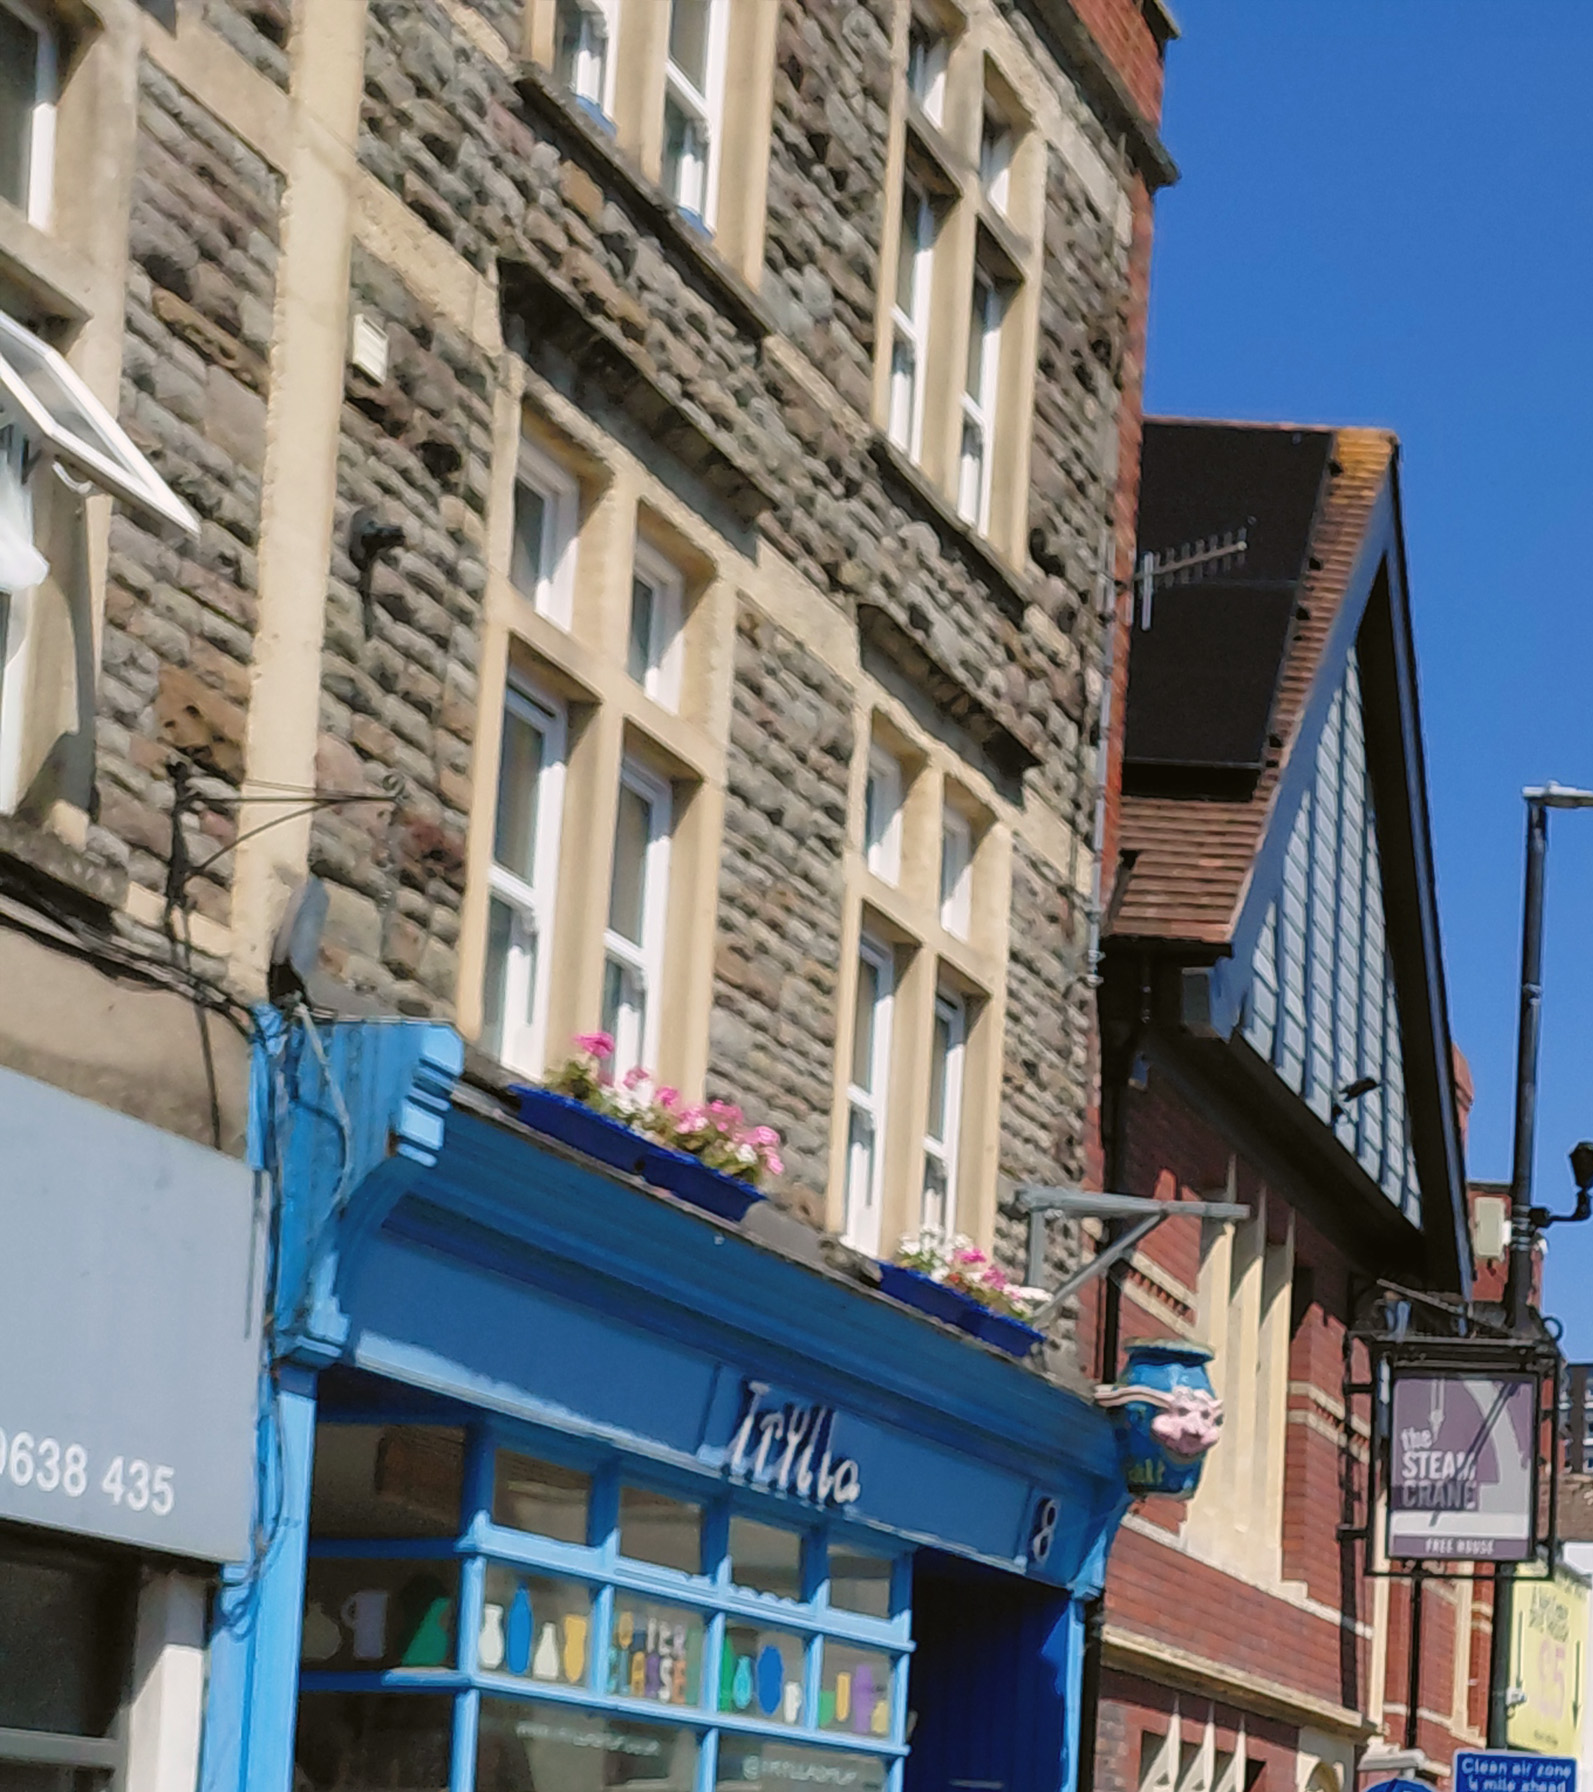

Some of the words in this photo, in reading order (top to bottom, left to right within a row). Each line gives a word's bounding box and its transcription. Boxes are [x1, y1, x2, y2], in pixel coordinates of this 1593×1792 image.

[1401, 1427, 1432, 1450] the
[1402, 1451, 1475, 1481] STEAM
[102, 1455, 175, 1516] 435
[1403, 1480, 1476, 1509] CRANE
[1426, 1539, 1452, 1554] FREE
[1457, 1539, 1494, 1555] HOUSE
[1462, 1757, 1508, 1775] Clean
[1512, 1759, 1531, 1776] air
[1536, 1763, 1571, 1778] zone
[1483, 1779, 1516, 1792] mile
